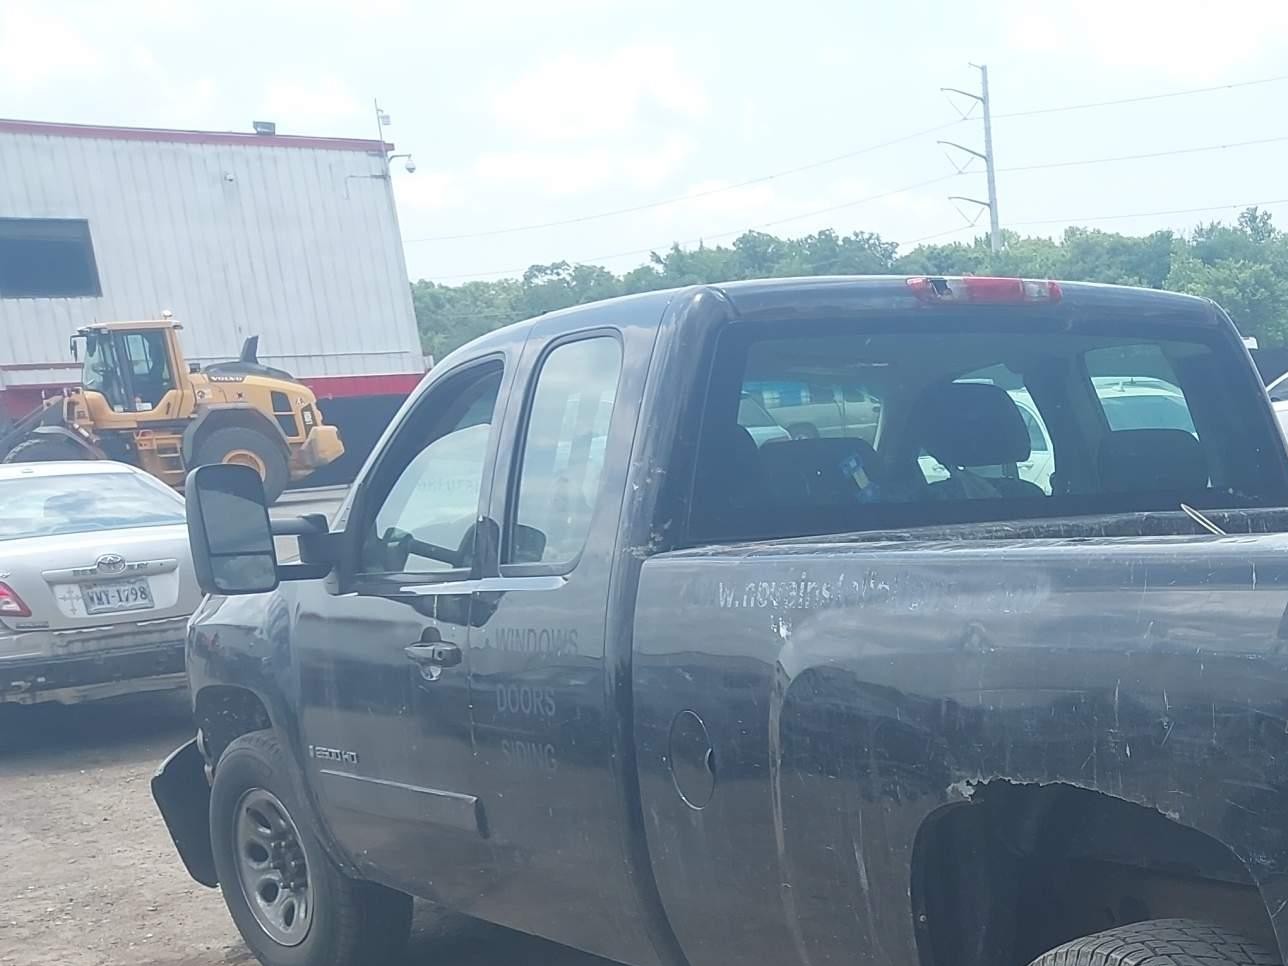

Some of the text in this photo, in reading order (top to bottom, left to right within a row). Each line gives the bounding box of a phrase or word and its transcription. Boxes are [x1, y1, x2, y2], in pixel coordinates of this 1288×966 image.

[495, 627, 579, 656] WINDOWS
[496, 684, 556, 716] DOORS
[500, 738, 559, 772] SIDING
